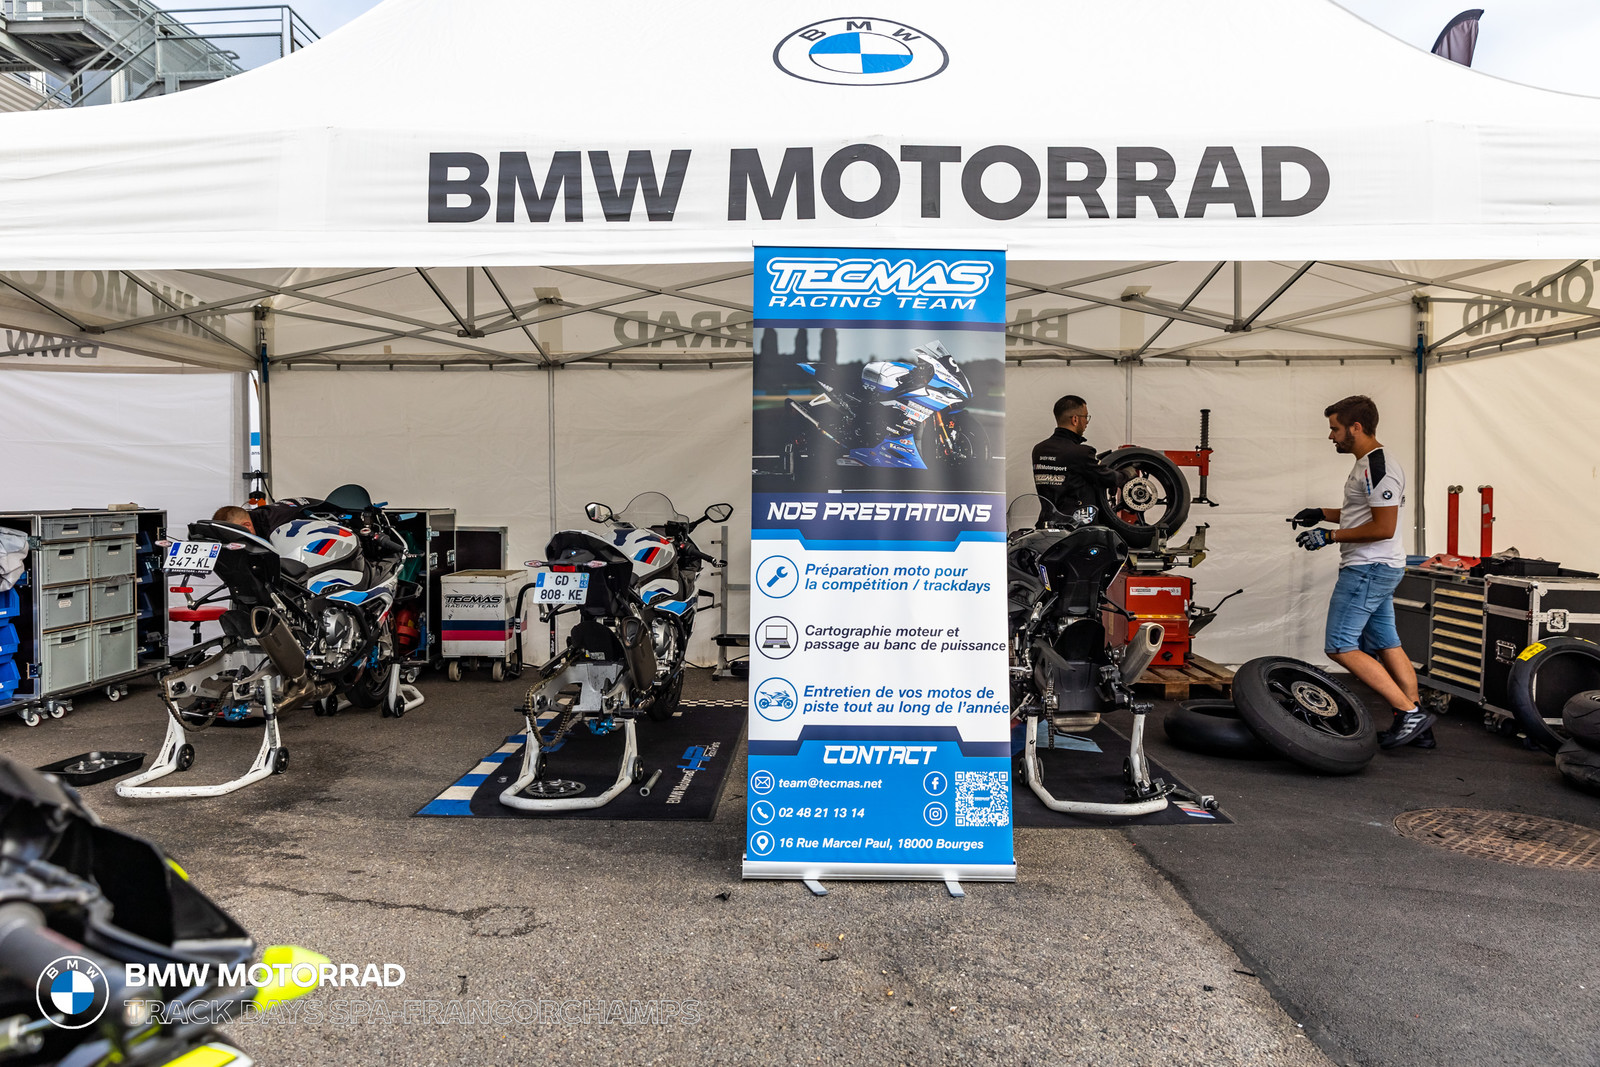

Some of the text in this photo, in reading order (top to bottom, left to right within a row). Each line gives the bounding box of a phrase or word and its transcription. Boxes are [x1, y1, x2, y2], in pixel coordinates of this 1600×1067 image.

[799, 20, 921, 42] BMW
[428, 144, 1331, 223] BMW MOTORRAD
[766, 256, 994, 297] TECMAS
[768, 296, 977, 310] RACING TEAM
[767, 502, 992, 522] NOS PRESTATIONS
[184, 544, 199, 554] GB
[804, 563, 969, 580] Préparation moto pour
[555, 575, 569, 586] GD
[804, 578, 991, 594] la compétition / trackdays
[444, 593, 503, 605] TECMAS
[805, 624, 960, 639] Cartographie moteur et
[803, 639, 1006, 653] passage au banc de puissance
[803, 685, 995, 699] Entretien de vos motos de
[802, 700, 1010, 716] piste tout au long de l’année
[822, 745, 938, 765] CONTACT
[778, 778, 883, 790] team@tecmas.net
[778, 807, 865, 818] 02 48 21 13 14
[779, 837, 984, 851] 16 Rue Marcel Paul, 18000 Bourges
